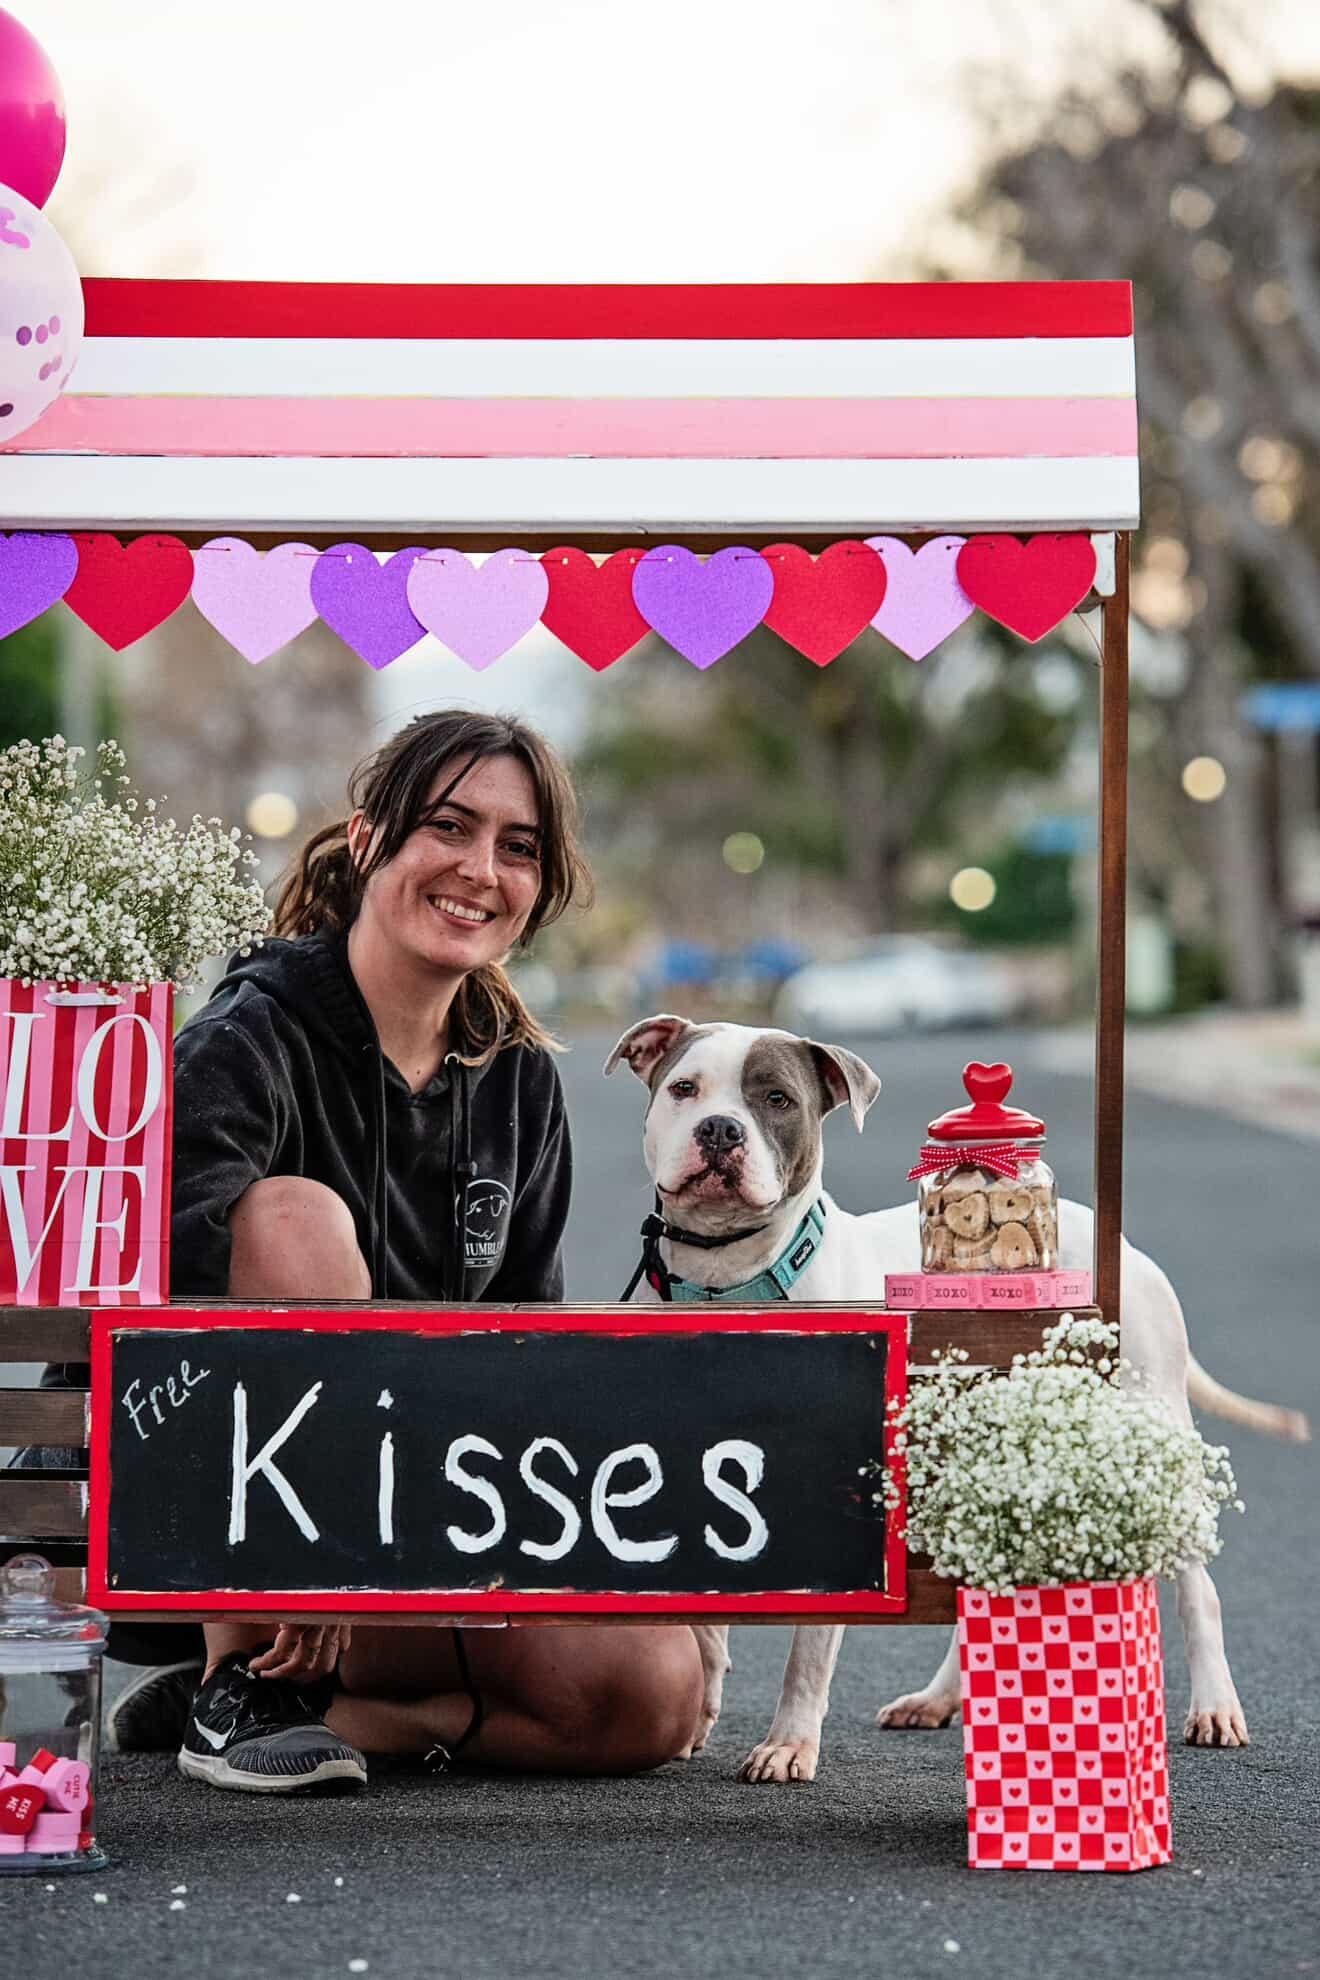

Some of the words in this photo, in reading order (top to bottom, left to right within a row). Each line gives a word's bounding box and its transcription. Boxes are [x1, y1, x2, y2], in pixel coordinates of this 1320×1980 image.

[0, 1011, 163, 1142] LO
[0, 1165, 147, 1293] VE
[934, 1287, 968, 1298] XOXO
[990, 1287, 1023, 1299] XOXO
[121, 1360, 211, 1440] Free
[228, 1380, 769, 1563] Kisses
[5, 1795, 20, 1812] ME
[15, 1797, 33, 1821] KISS
